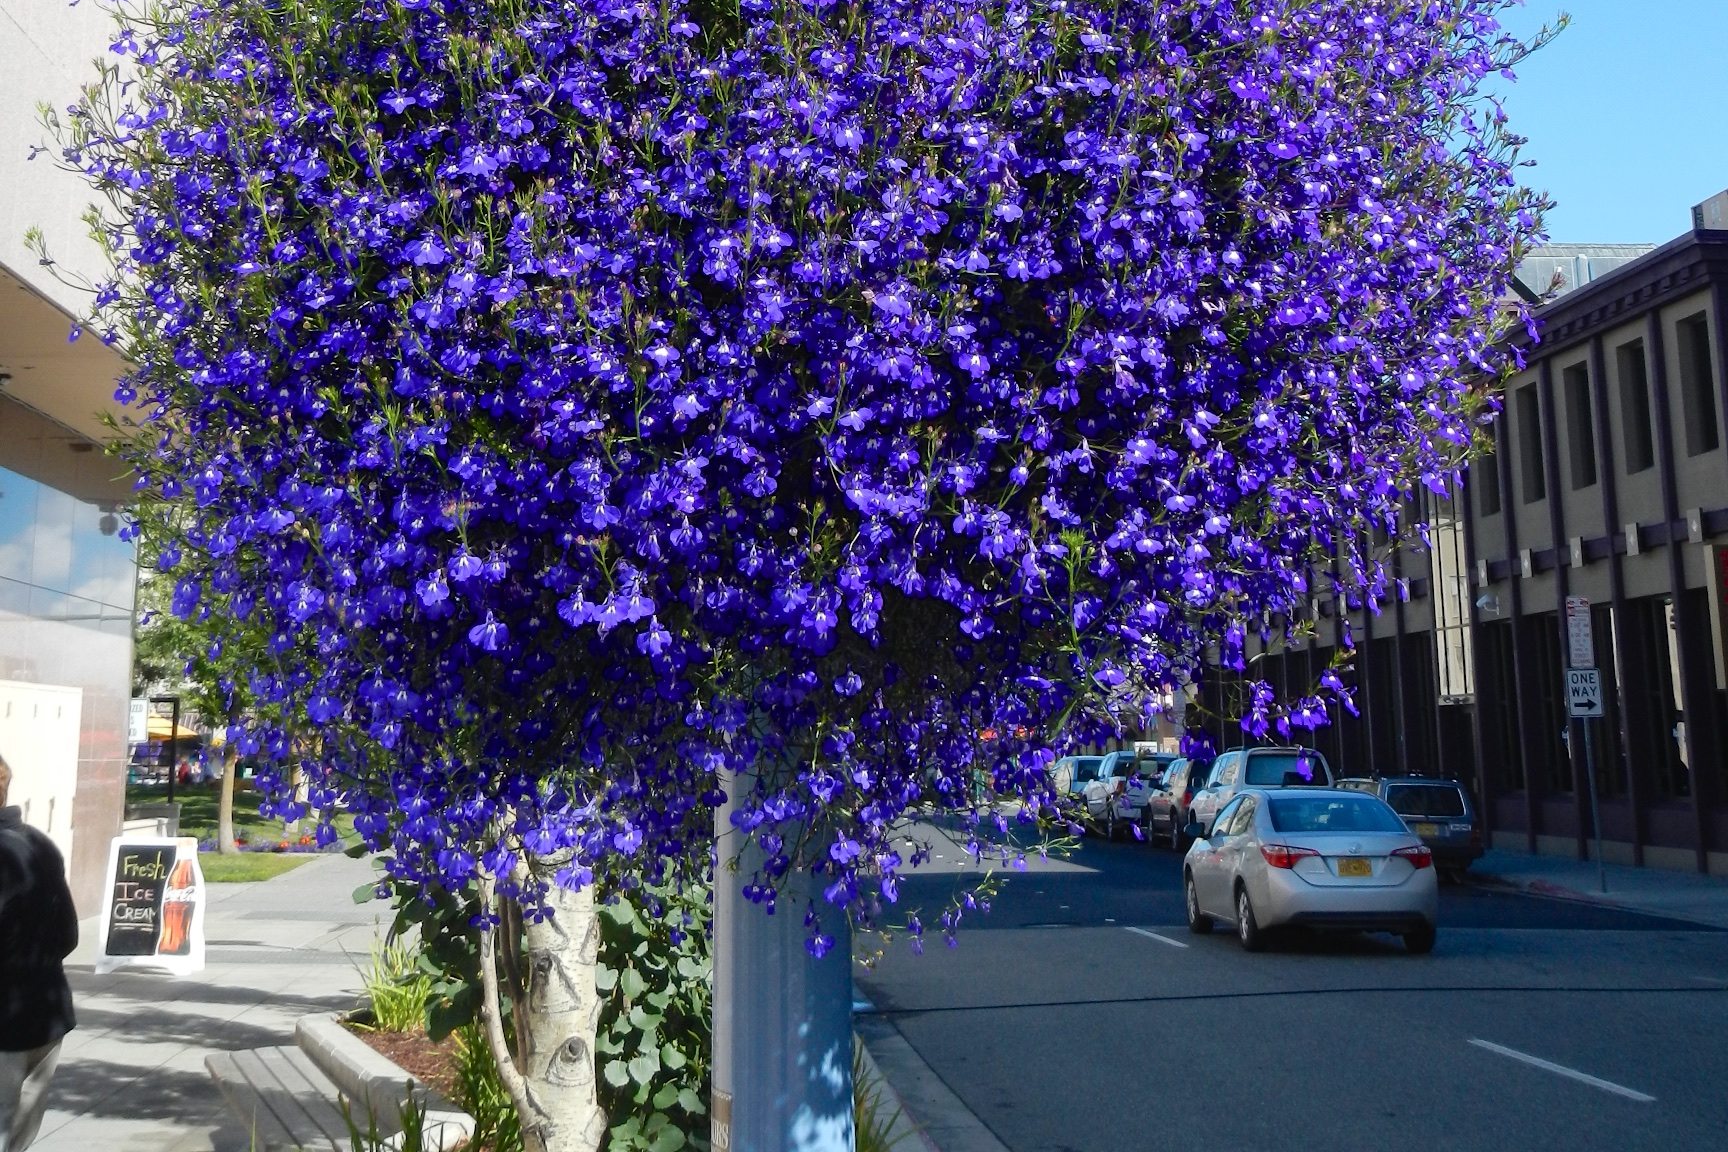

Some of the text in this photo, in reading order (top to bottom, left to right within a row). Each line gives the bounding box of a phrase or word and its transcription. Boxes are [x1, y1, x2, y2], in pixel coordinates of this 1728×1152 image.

[1571, 673, 1595, 684] ONE
[1571, 686, 1597, 697] WAY
[123, 851, 167, 880] Fresh
